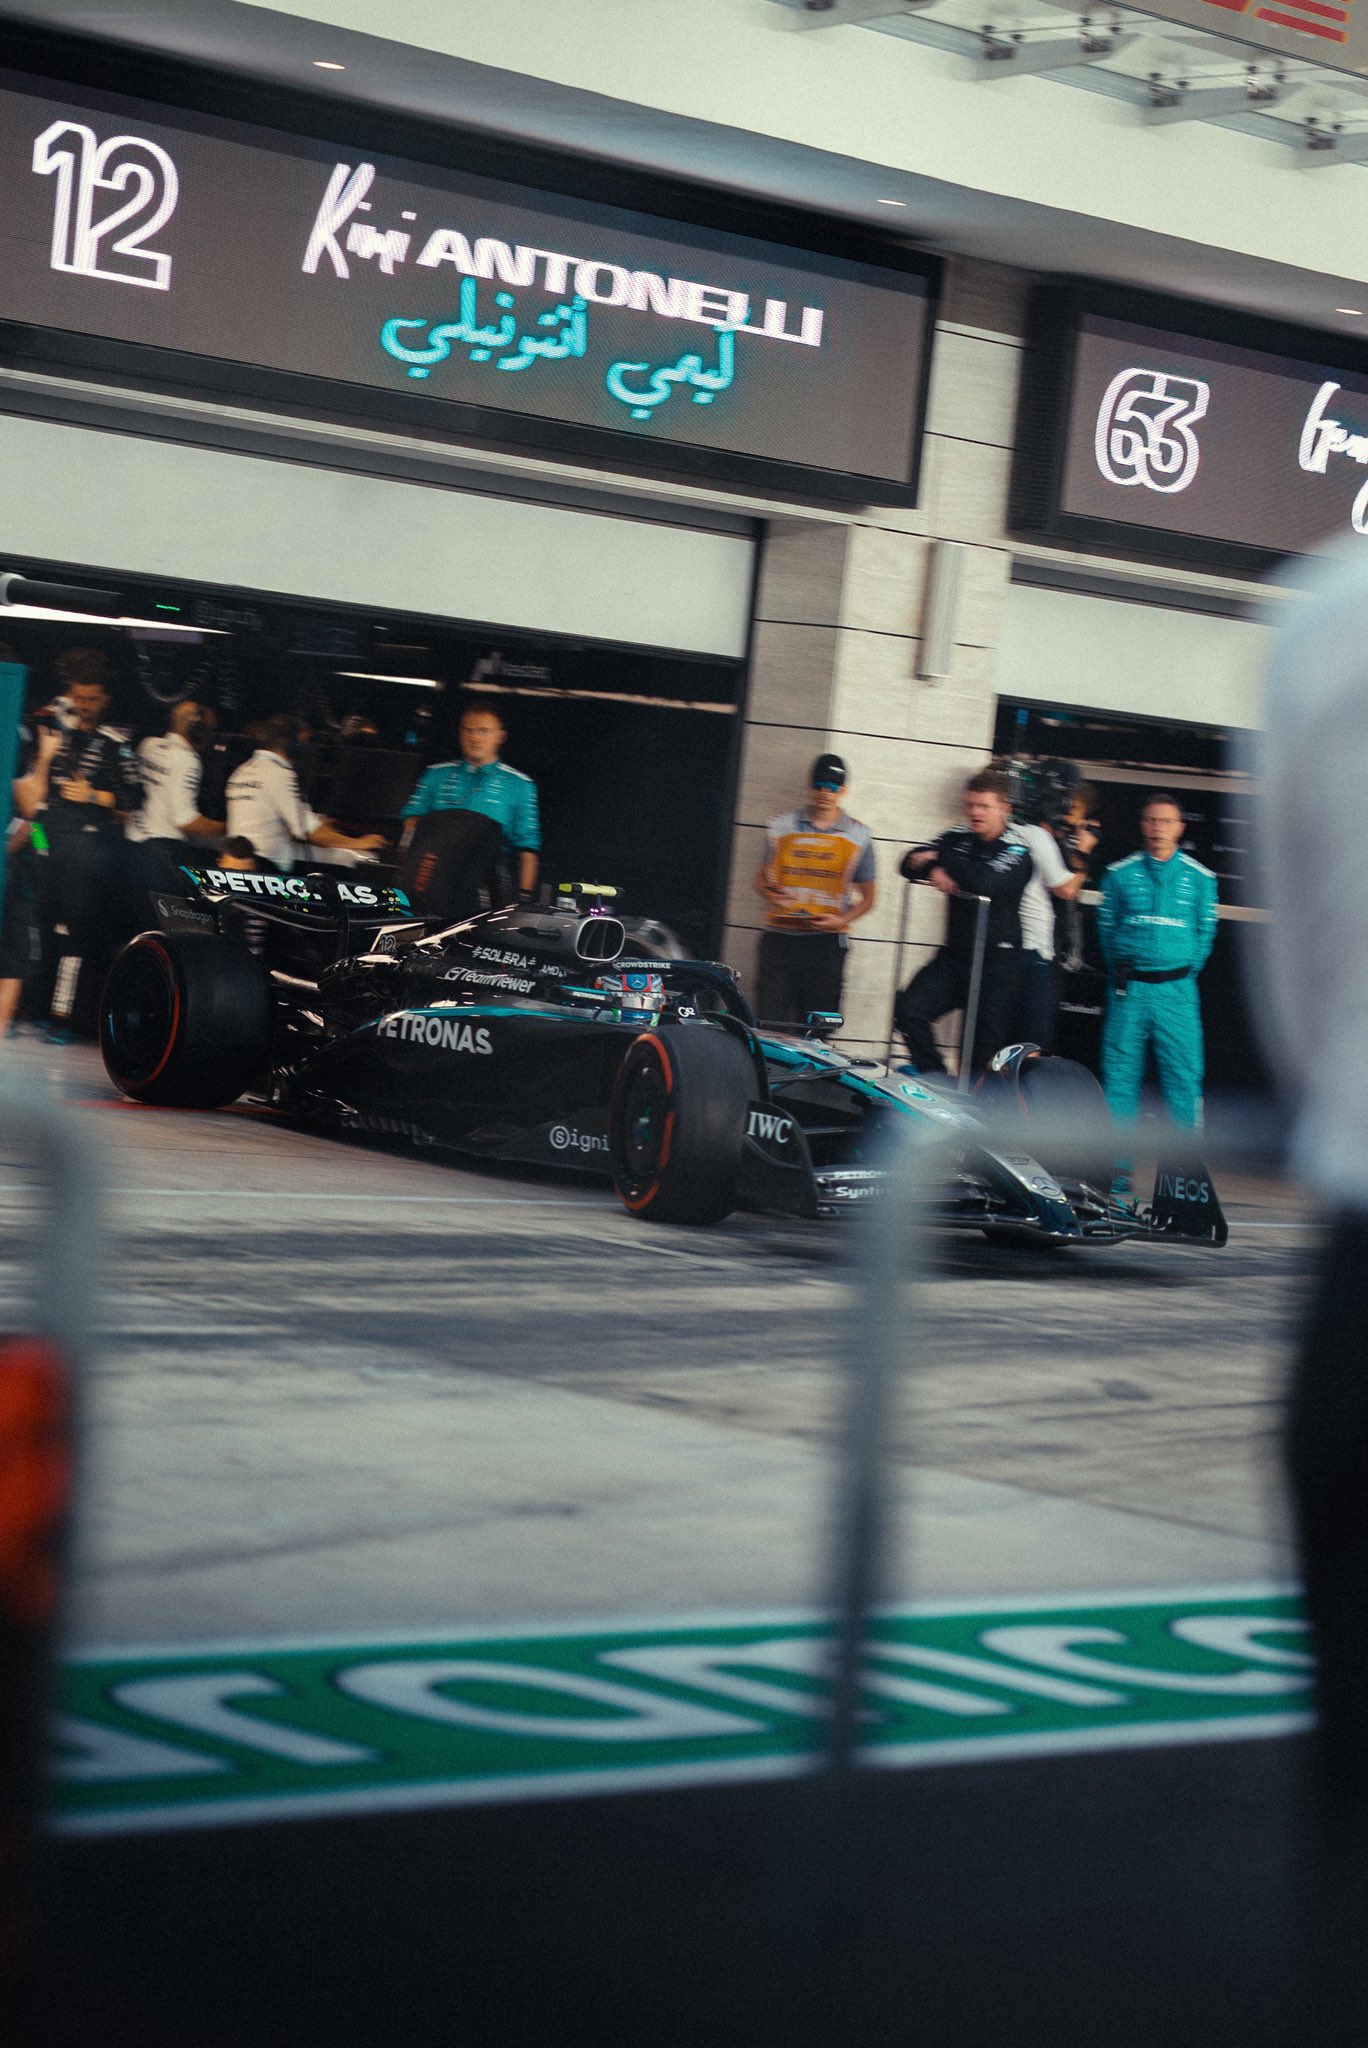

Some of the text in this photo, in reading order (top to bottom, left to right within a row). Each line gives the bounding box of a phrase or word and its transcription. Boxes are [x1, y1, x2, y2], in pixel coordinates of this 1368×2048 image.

[32, 120, 178, 290] 12
[415, 229, 824, 347] ANTONELLI
[1095, 367, 1209, 493] 63
[206, 869, 379, 905] PETROAS
[480, 948, 527, 968] SOLERA
[616, 961, 671, 970] CROWDSTRIKE
[376, 1012, 493, 1055] PETRONAS
[549, 1125, 610, 1152] signi
[746, 1111, 792, 1143] IWC
[1158, 1174, 1209, 1204] INEOS
